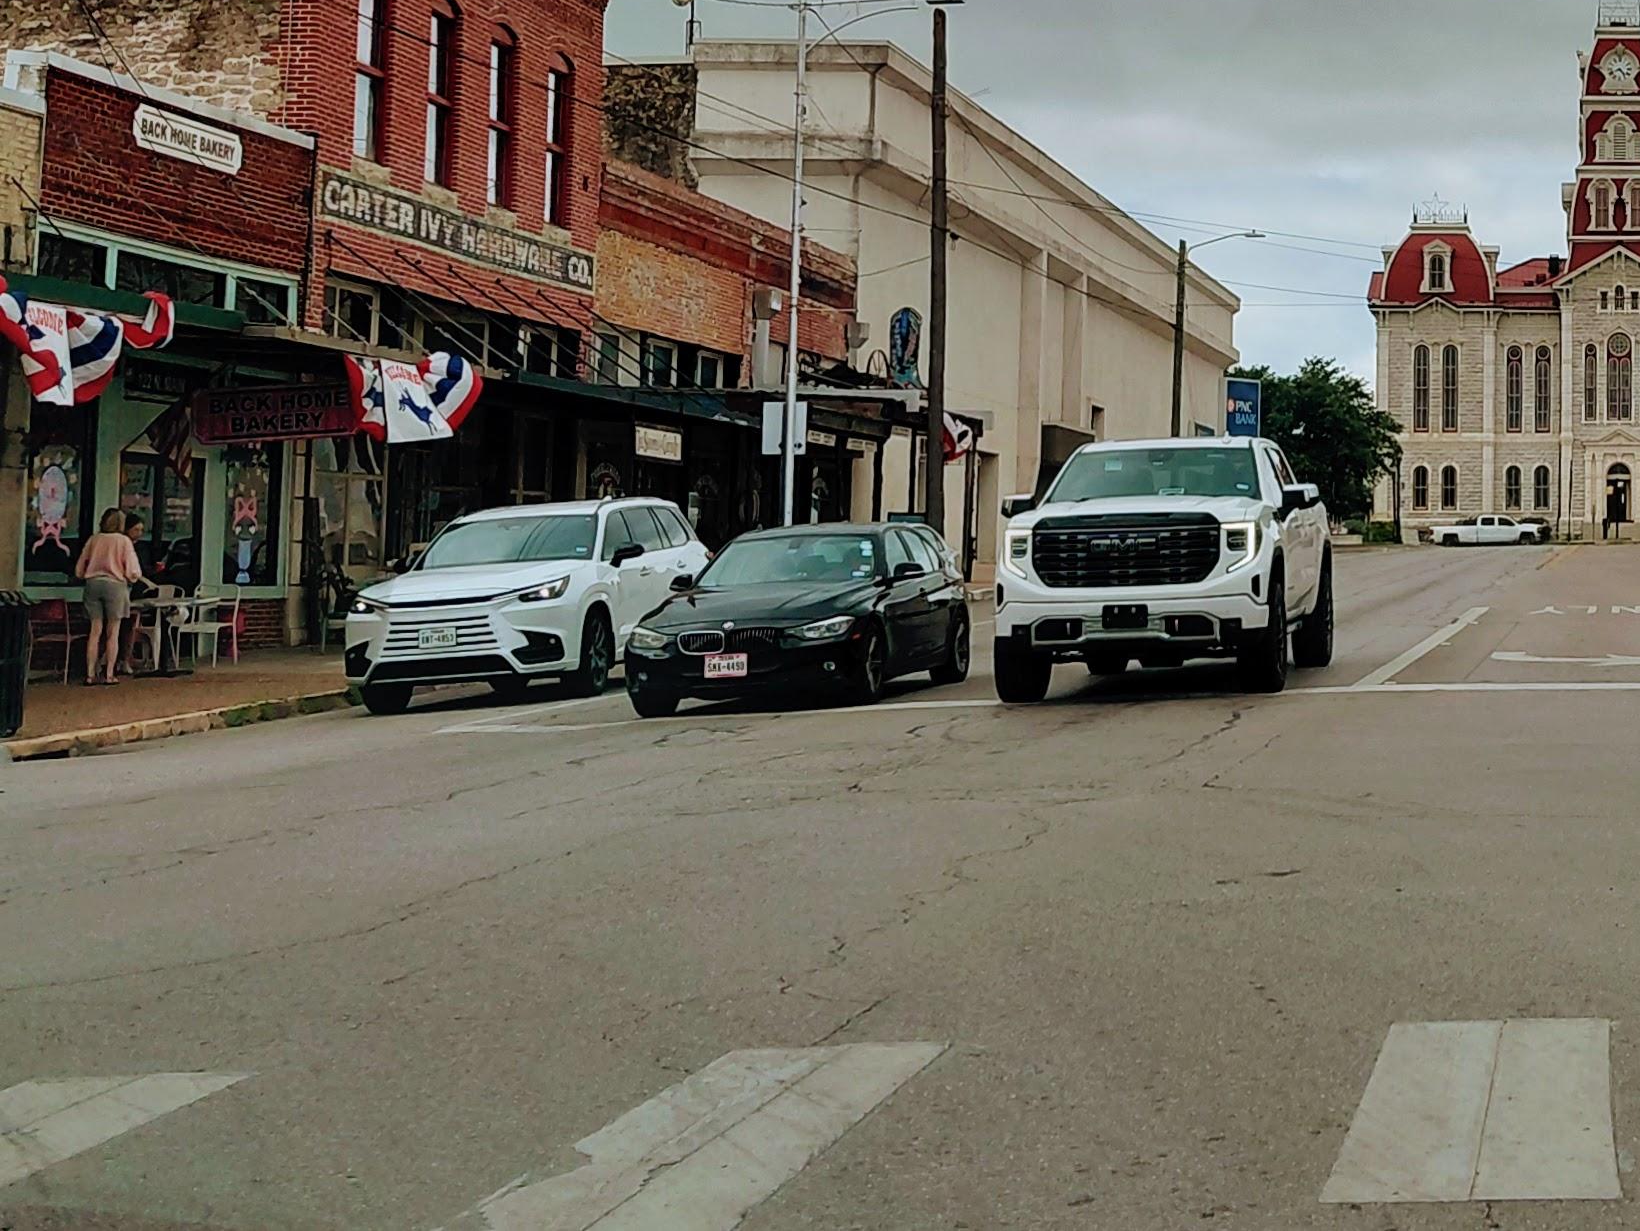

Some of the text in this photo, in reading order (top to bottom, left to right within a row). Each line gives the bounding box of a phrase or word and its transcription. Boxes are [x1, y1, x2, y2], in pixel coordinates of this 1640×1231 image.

[141, 117, 236, 161] BACK HOME BAKERY
[323, 180, 414, 235] CARTER
[419, 206, 458, 245] IVY
[461, 223, 564, 278] HARDWARE
[208, 390, 349, 415] BACK HOME
[1235, 400, 1253, 413] PNC
[230, 411, 325, 435] BAKERY
[1235, 413, 1257, 426] BANK
[1090, 537, 1157, 551] GMC
